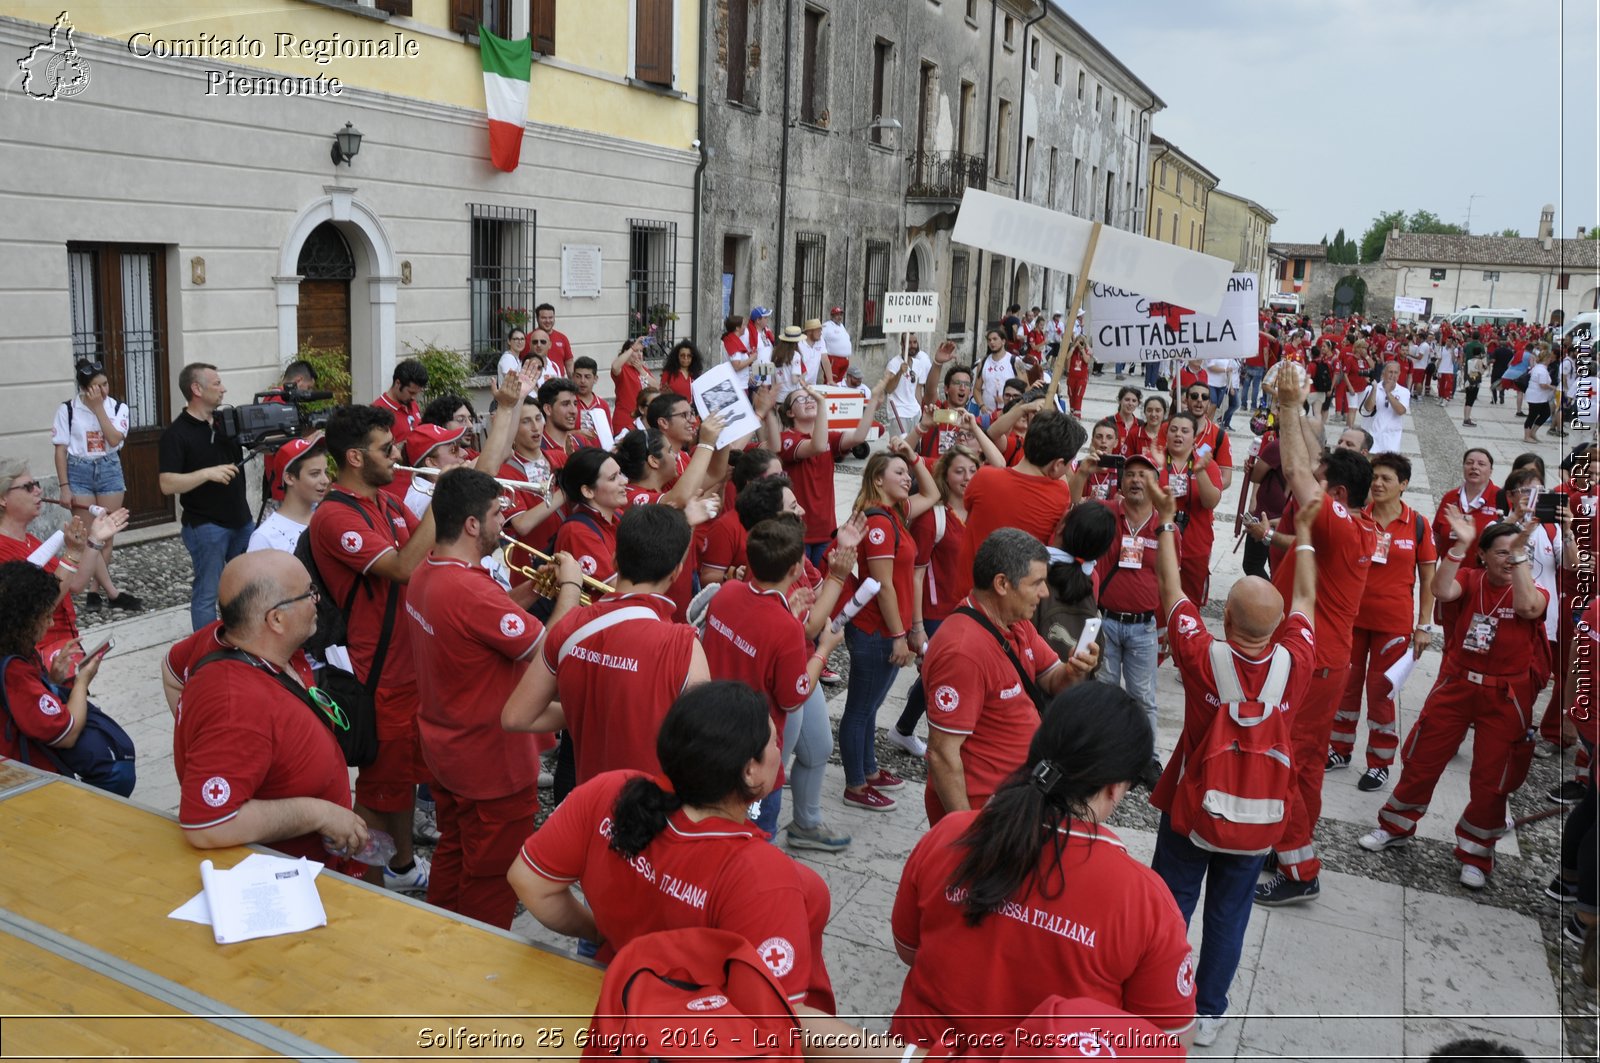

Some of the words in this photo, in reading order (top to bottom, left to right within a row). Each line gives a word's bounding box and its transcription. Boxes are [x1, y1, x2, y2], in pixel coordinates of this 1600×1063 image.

[888, 294, 933, 306] RICCIONE
[898, 314, 922, 323] ITALY
[1099, 319, 1237, 347] CITTADELLA
[1139, 345, 1198, 361] (PADOVA)
[602, 653, 639, 672] ITALIANA
[659, 873, 708, 910] ITALIANA
[1031, 908, 1097, 948] ITALIANA
